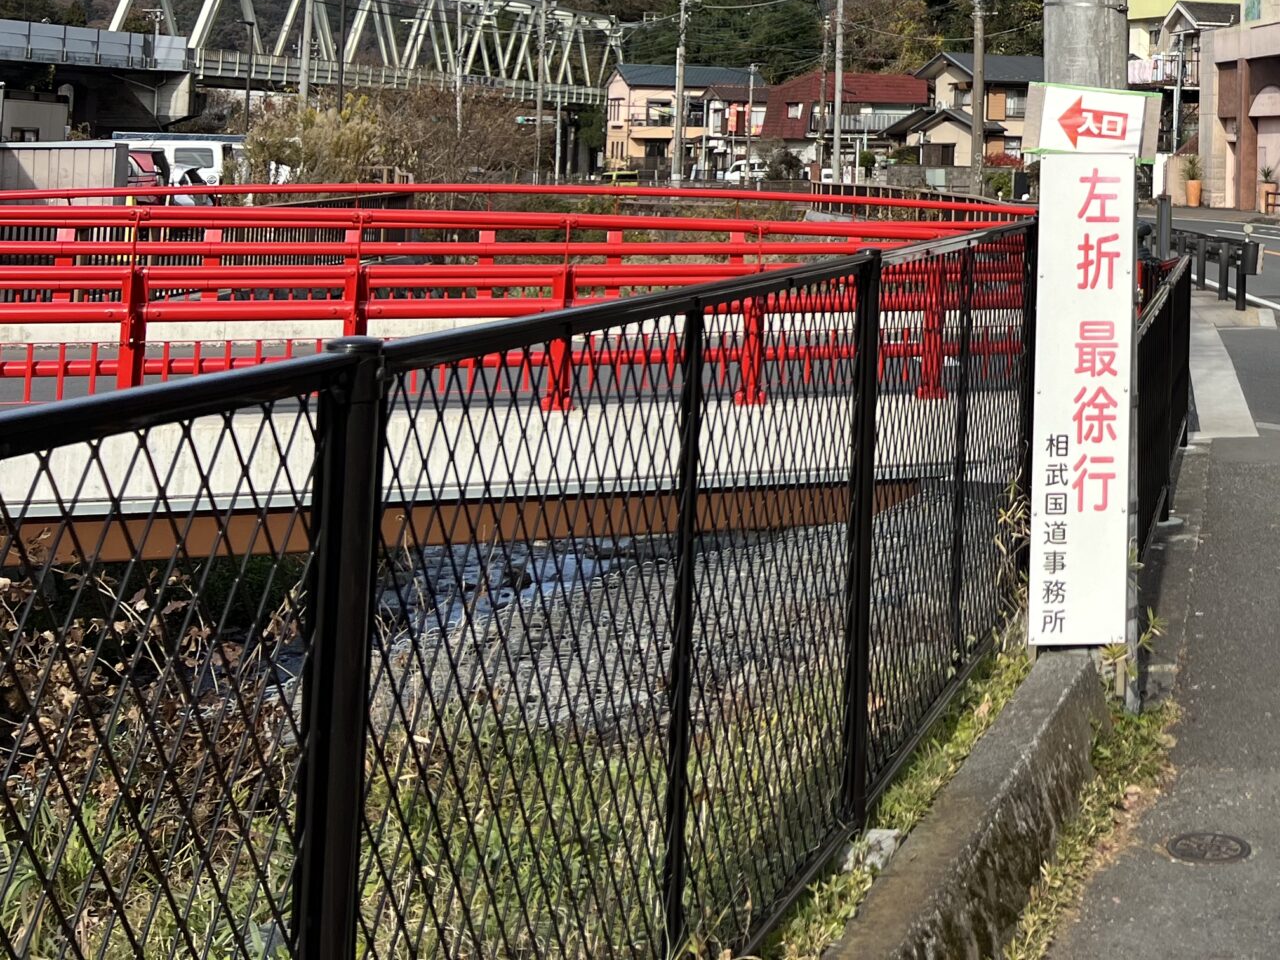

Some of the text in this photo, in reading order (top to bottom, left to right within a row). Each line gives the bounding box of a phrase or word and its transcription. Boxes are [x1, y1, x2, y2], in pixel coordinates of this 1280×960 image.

[1077, 112, 1124, 136] 入口
[1072, 167, 1121, 513] 左折 最徐行
[1041, 433, 1069, 634] 相武国道事務所
